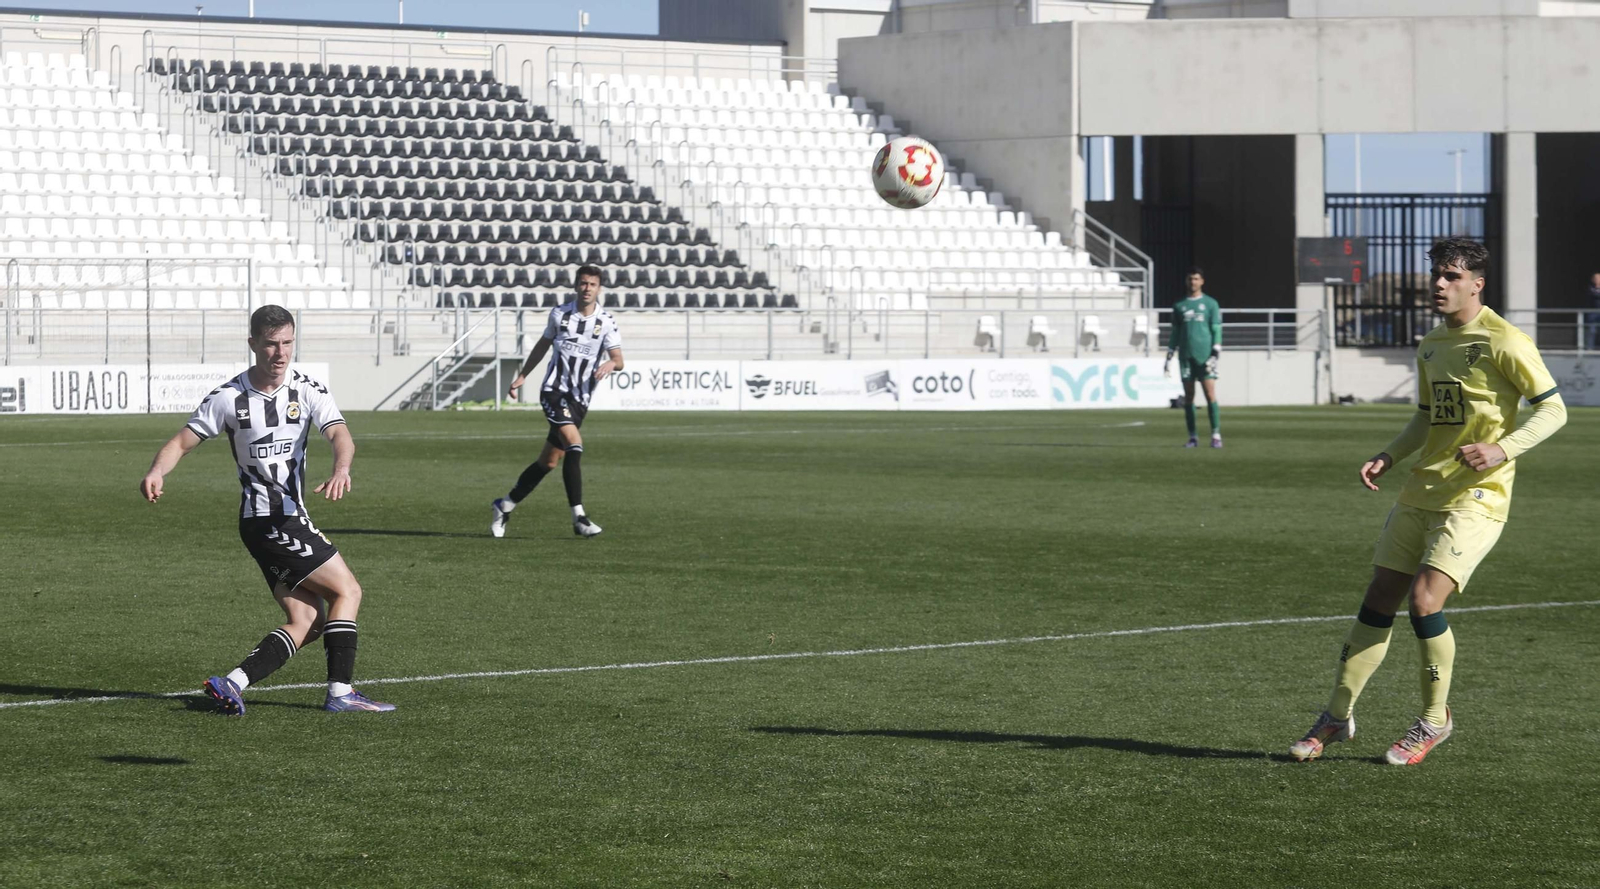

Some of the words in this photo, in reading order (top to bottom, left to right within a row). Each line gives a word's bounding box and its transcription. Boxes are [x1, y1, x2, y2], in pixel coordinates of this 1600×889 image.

[561, 341, 591, 355] LOTUS
[52, 371, 128, 410] UBAGO
[608, 371, 642, 390] TOP
[649, 368, 733, 392] VERTICAL
[912, 371, 963, 393] coto
[249, 442, 293, 459] LOTUS
